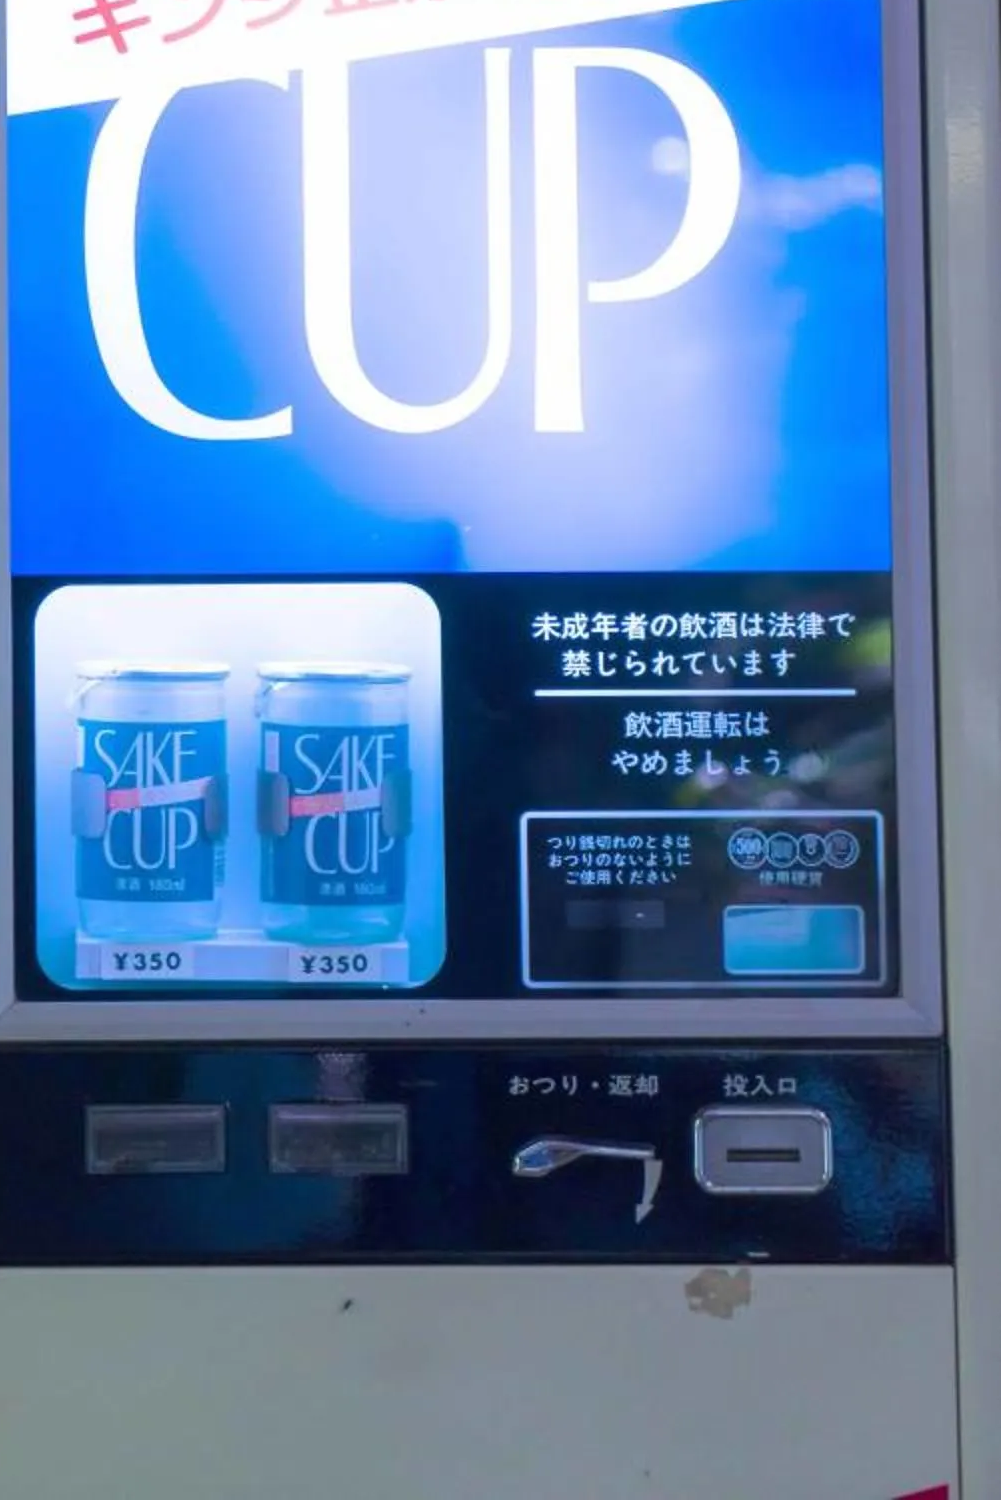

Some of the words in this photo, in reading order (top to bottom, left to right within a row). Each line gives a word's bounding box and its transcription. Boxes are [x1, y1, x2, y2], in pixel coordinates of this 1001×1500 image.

[83, 46, 742, 441] CUP
[532, 612, 856, 641] 未成年者の飲酒は法律で
[562, 649, 796, 678] 禁じられています
[624, 711, 770, 739] 飲酒運転は
[94, 728, 198, 788] SAKE
[295, 732, 397, 795] SAKE
[612, 748, 782, 776] やめましょう
[103, 808, 198, 871] CUP
[546, 835, 692, 851] つり銭切れのときは
[548, 853, 693, 868] おつりのないように
[565, 870, 677, 886] ご使用ください
[113, 951, 182, 972] ¥350
[301, 953, 368, 975] ¥350
[507, 1074, 659, 1096] おつり・返却
[722, 1073, 798, 1097] 投入口
